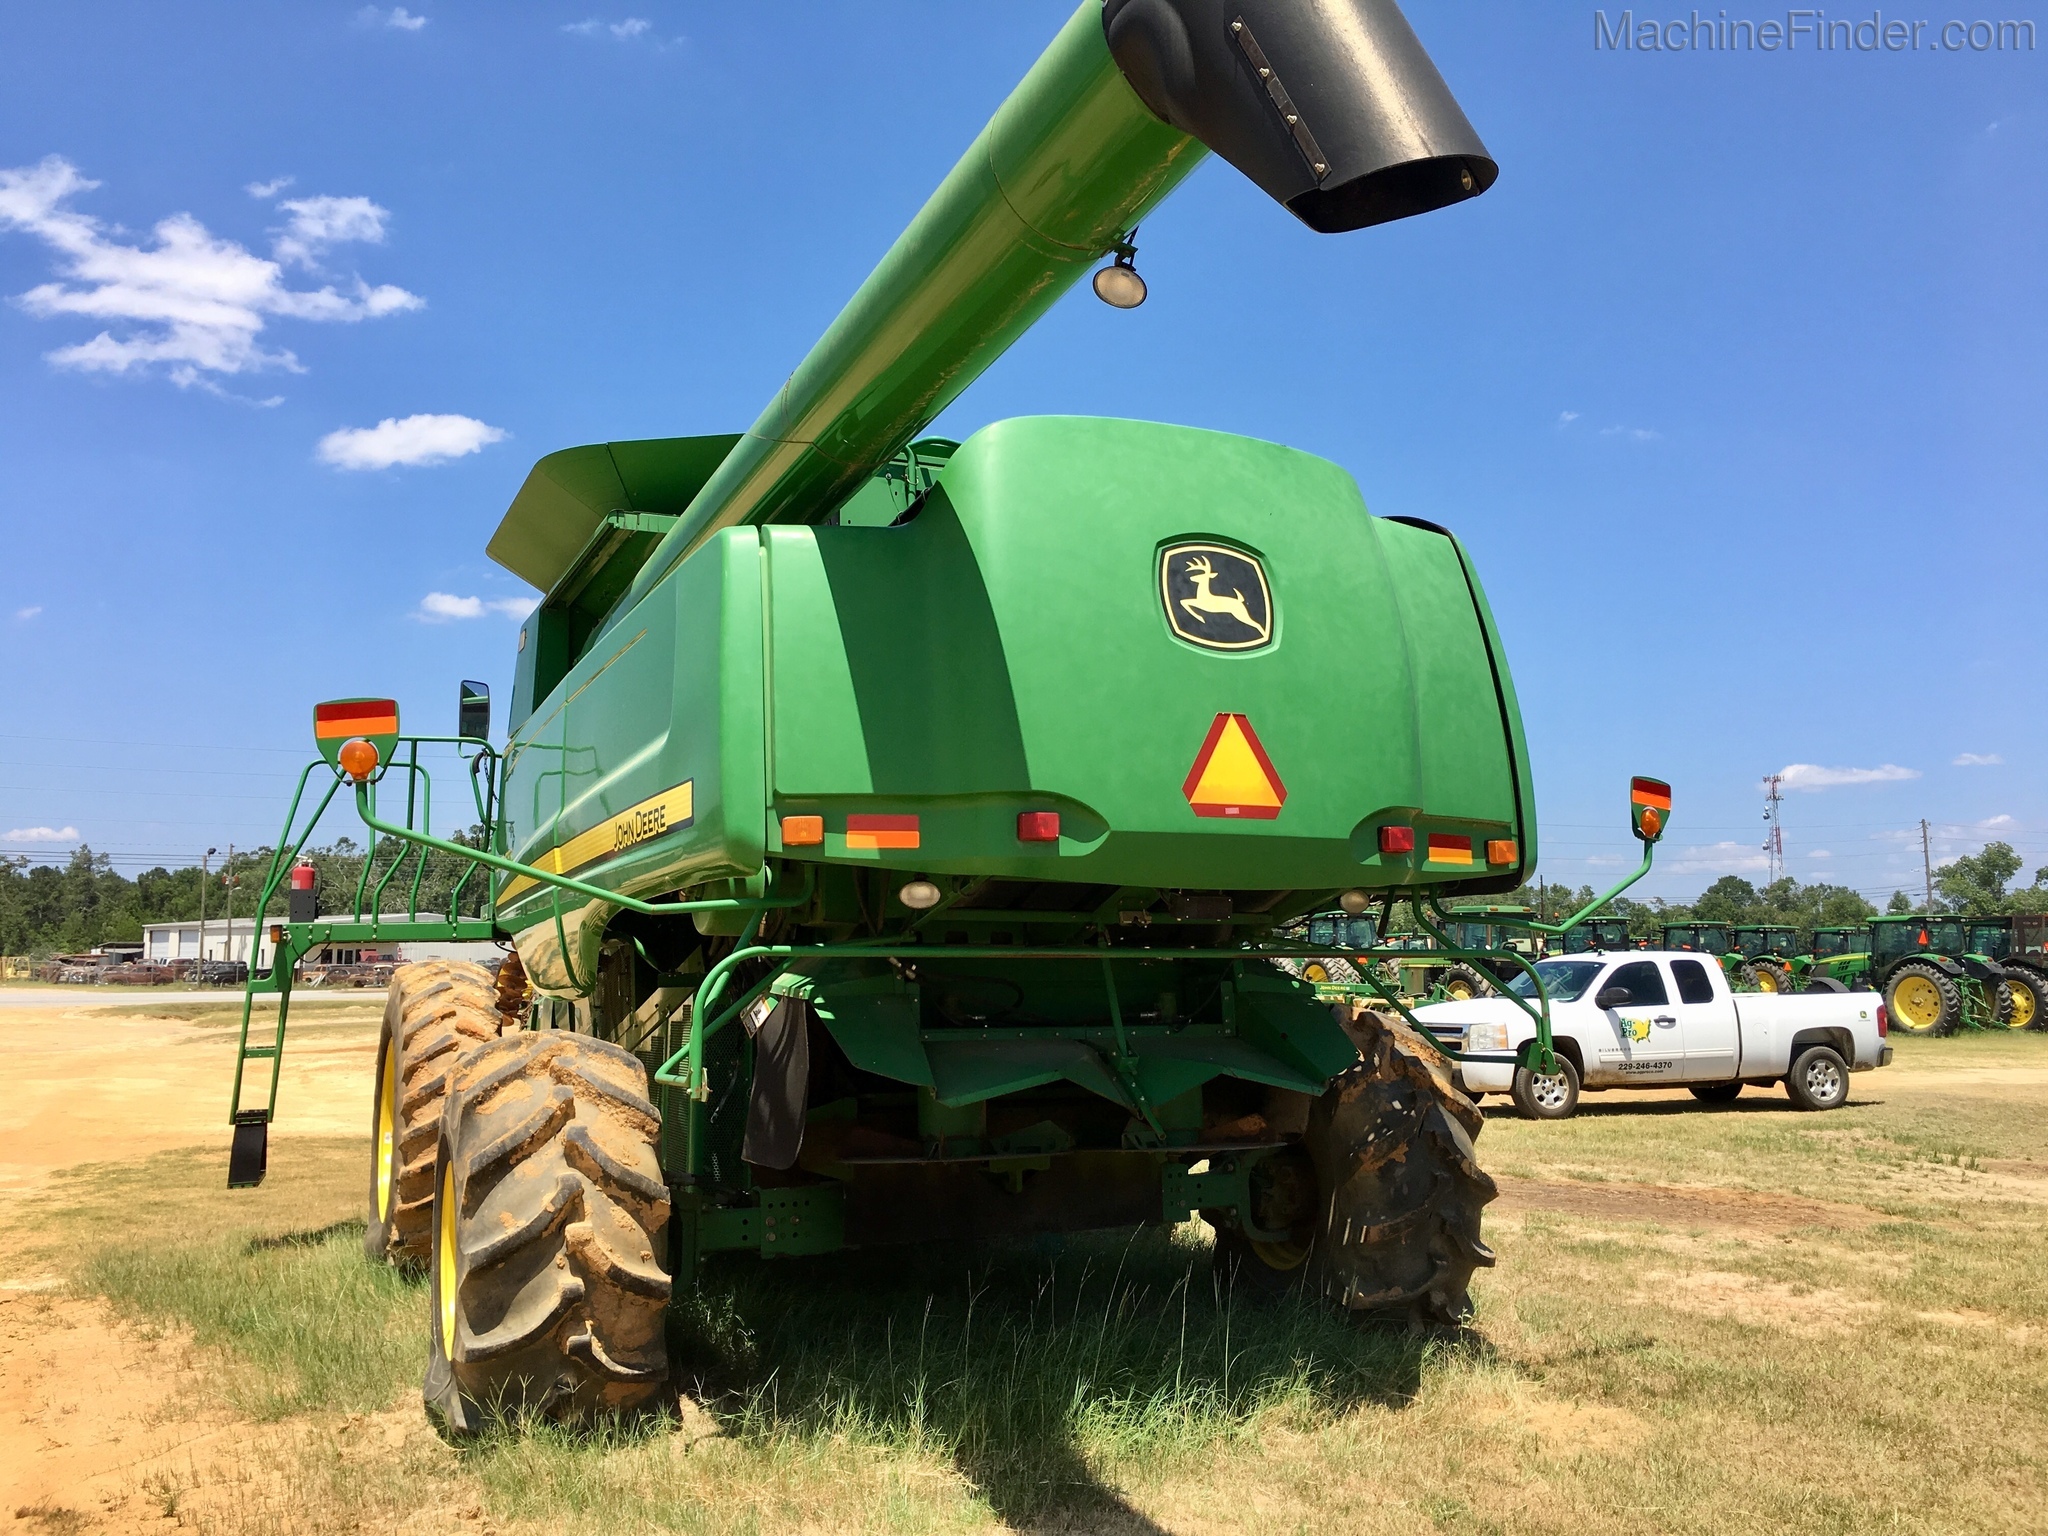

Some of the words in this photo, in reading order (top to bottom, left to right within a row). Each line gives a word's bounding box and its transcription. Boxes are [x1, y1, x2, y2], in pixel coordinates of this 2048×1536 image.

[614, 819, 635, 849] JOHN
[635, 804, 666, 839] DEERE
[1620, 1018, 1636, 1029] Ag-
[1620, 1028, 1638, 1037] Pro
[1618, 1061, 1673, 1070] 229-246-4370
